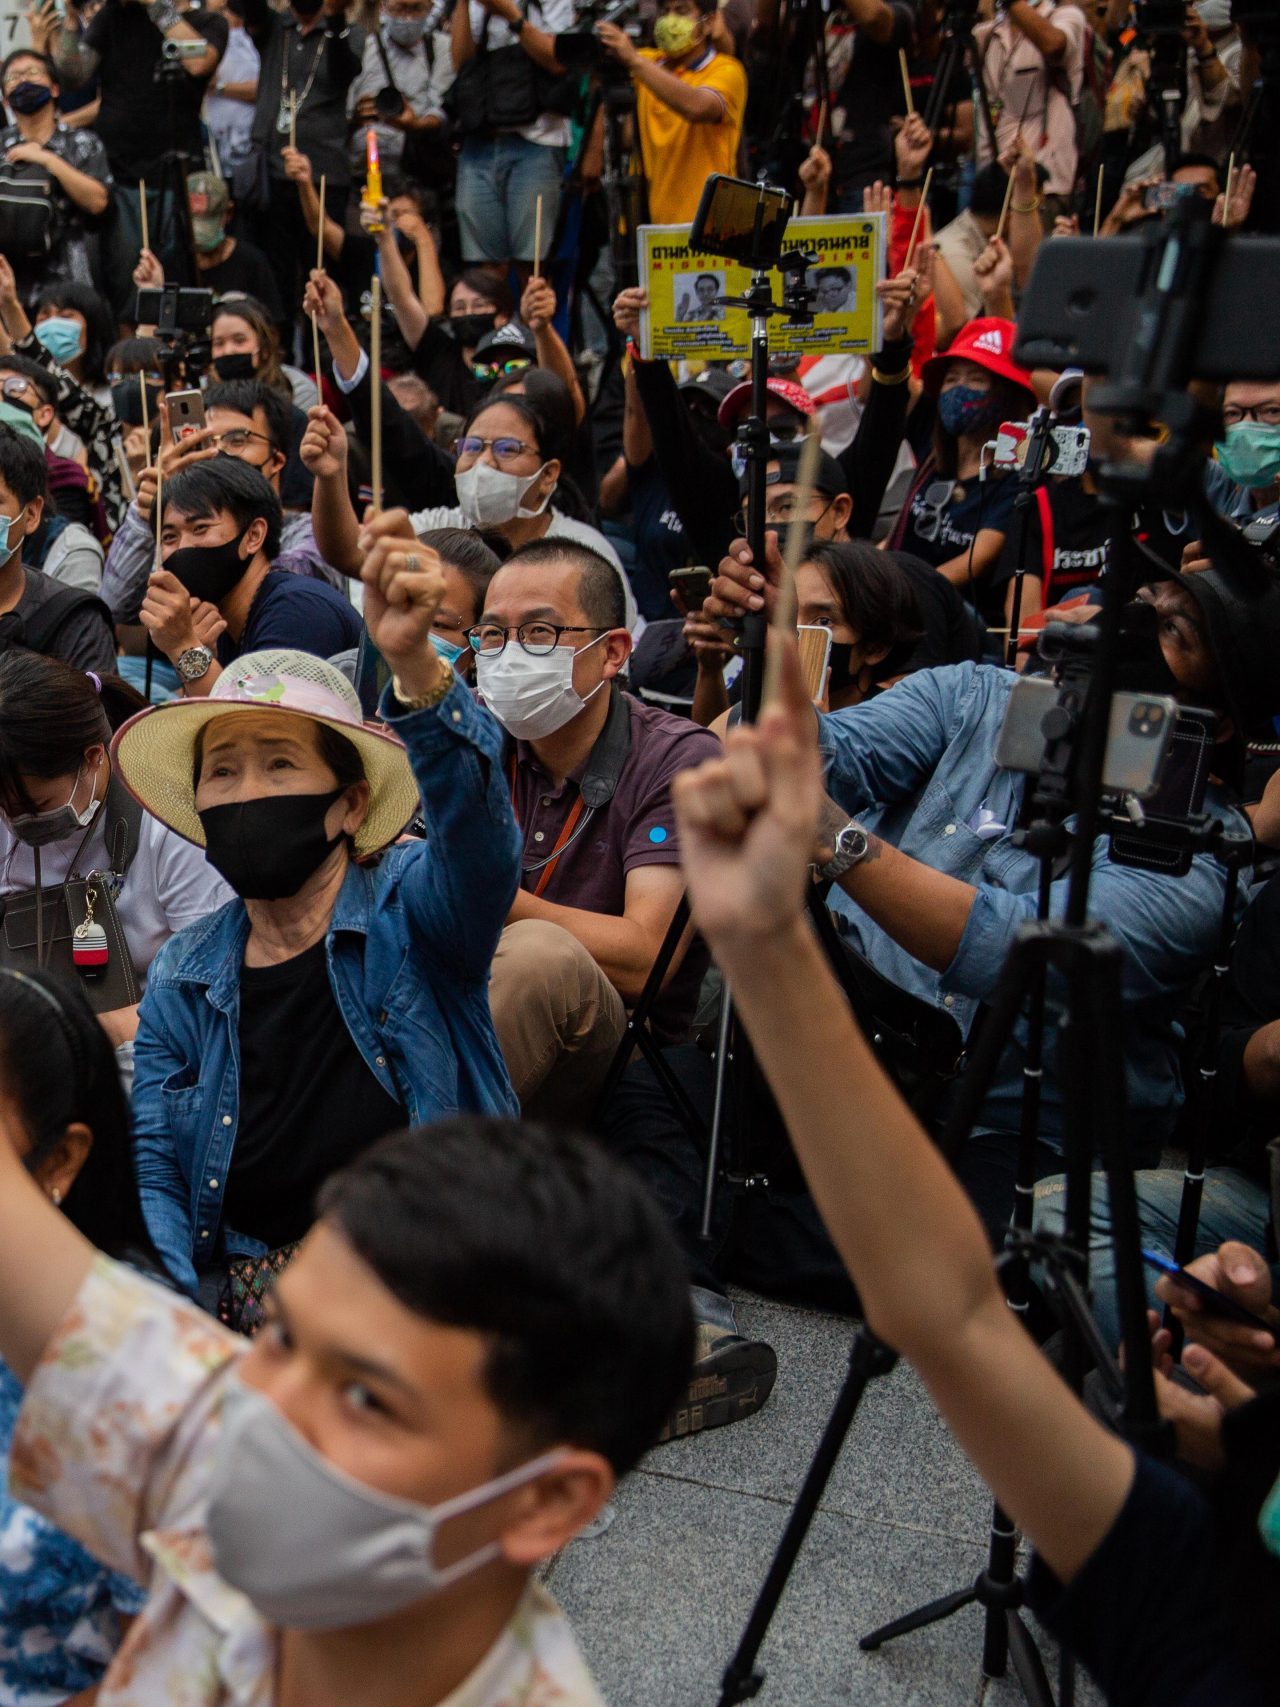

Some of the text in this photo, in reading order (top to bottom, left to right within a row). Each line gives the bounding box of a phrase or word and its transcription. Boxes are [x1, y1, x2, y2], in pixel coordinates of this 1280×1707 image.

[4, 13, 19, 41] 7
[781, 235, 869, 252] ามหาคนหาย
